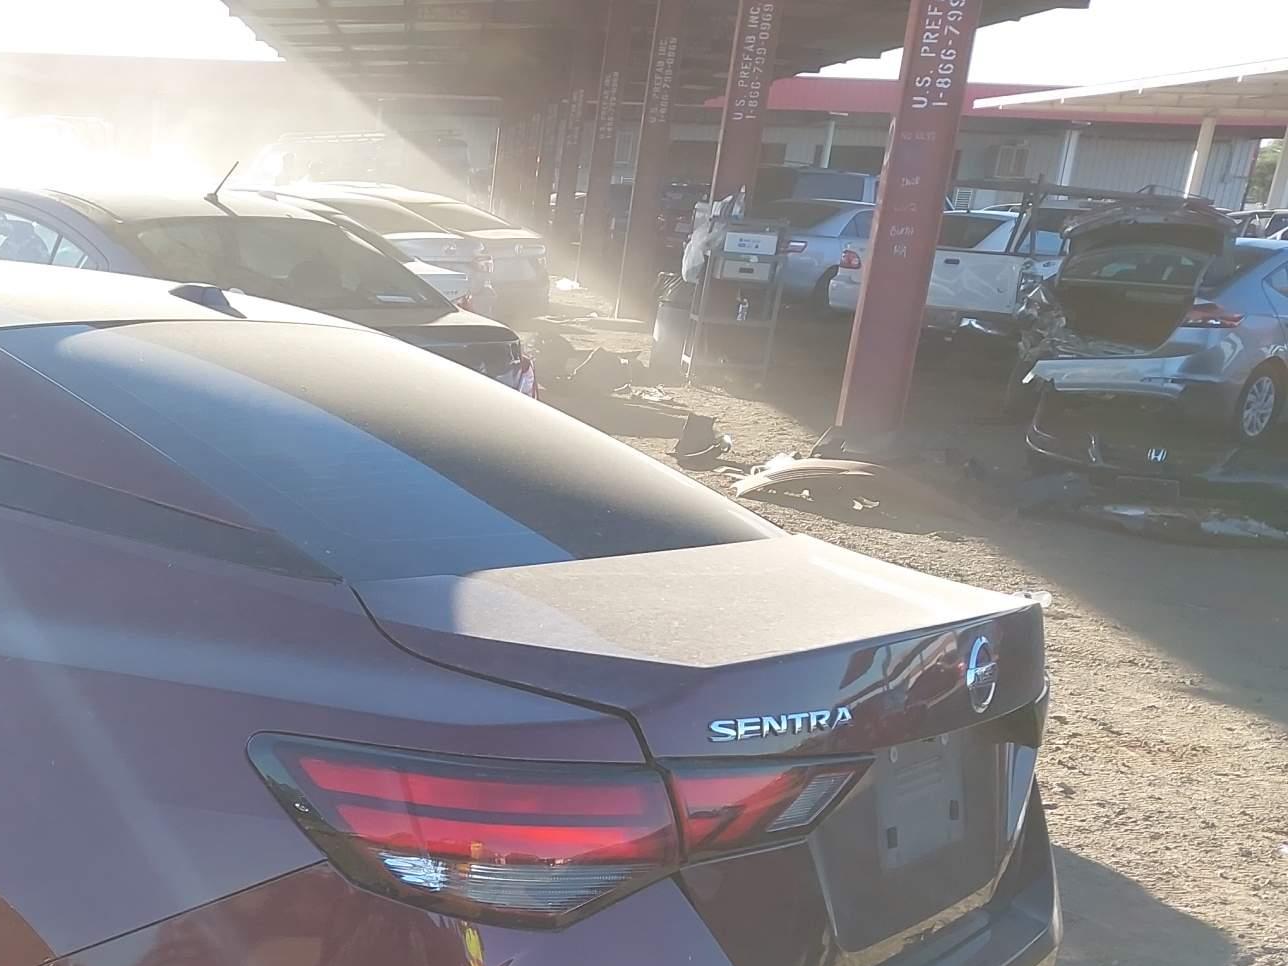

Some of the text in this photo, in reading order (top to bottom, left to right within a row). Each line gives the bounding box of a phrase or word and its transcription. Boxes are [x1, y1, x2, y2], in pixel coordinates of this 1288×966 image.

[920, 0, 945, 57] PREF
[737, 35, 756, 88] PREFAB
[911, 70, 934, 108] U.S.
[709, 705, 853, 743] SENTRA
